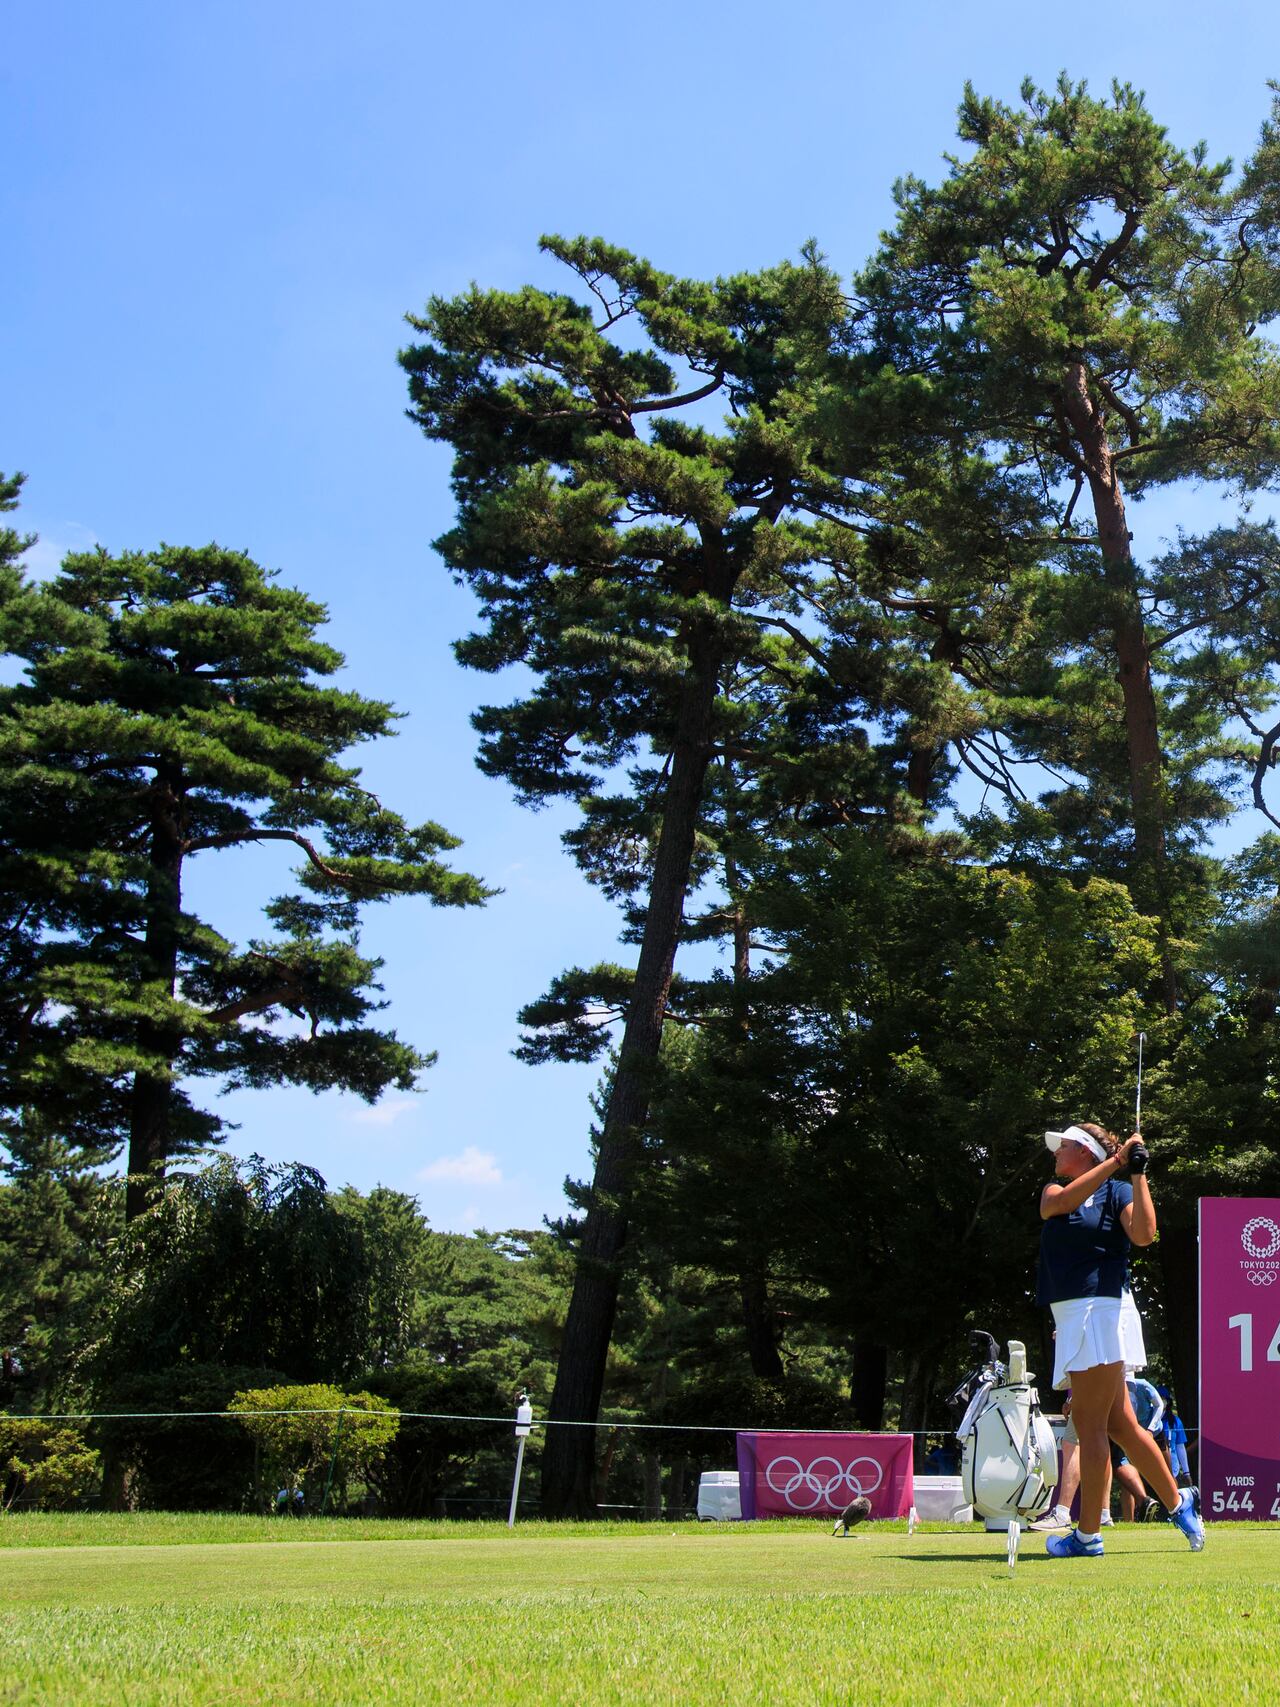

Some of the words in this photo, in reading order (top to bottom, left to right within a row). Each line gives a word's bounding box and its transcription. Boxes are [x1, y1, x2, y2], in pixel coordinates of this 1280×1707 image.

[1240, 1261, 1265, 1269] TOKYO
[1225, 1476, 1255, 1487] YARDS
[1212, 1491, 1255, 1513] 544
